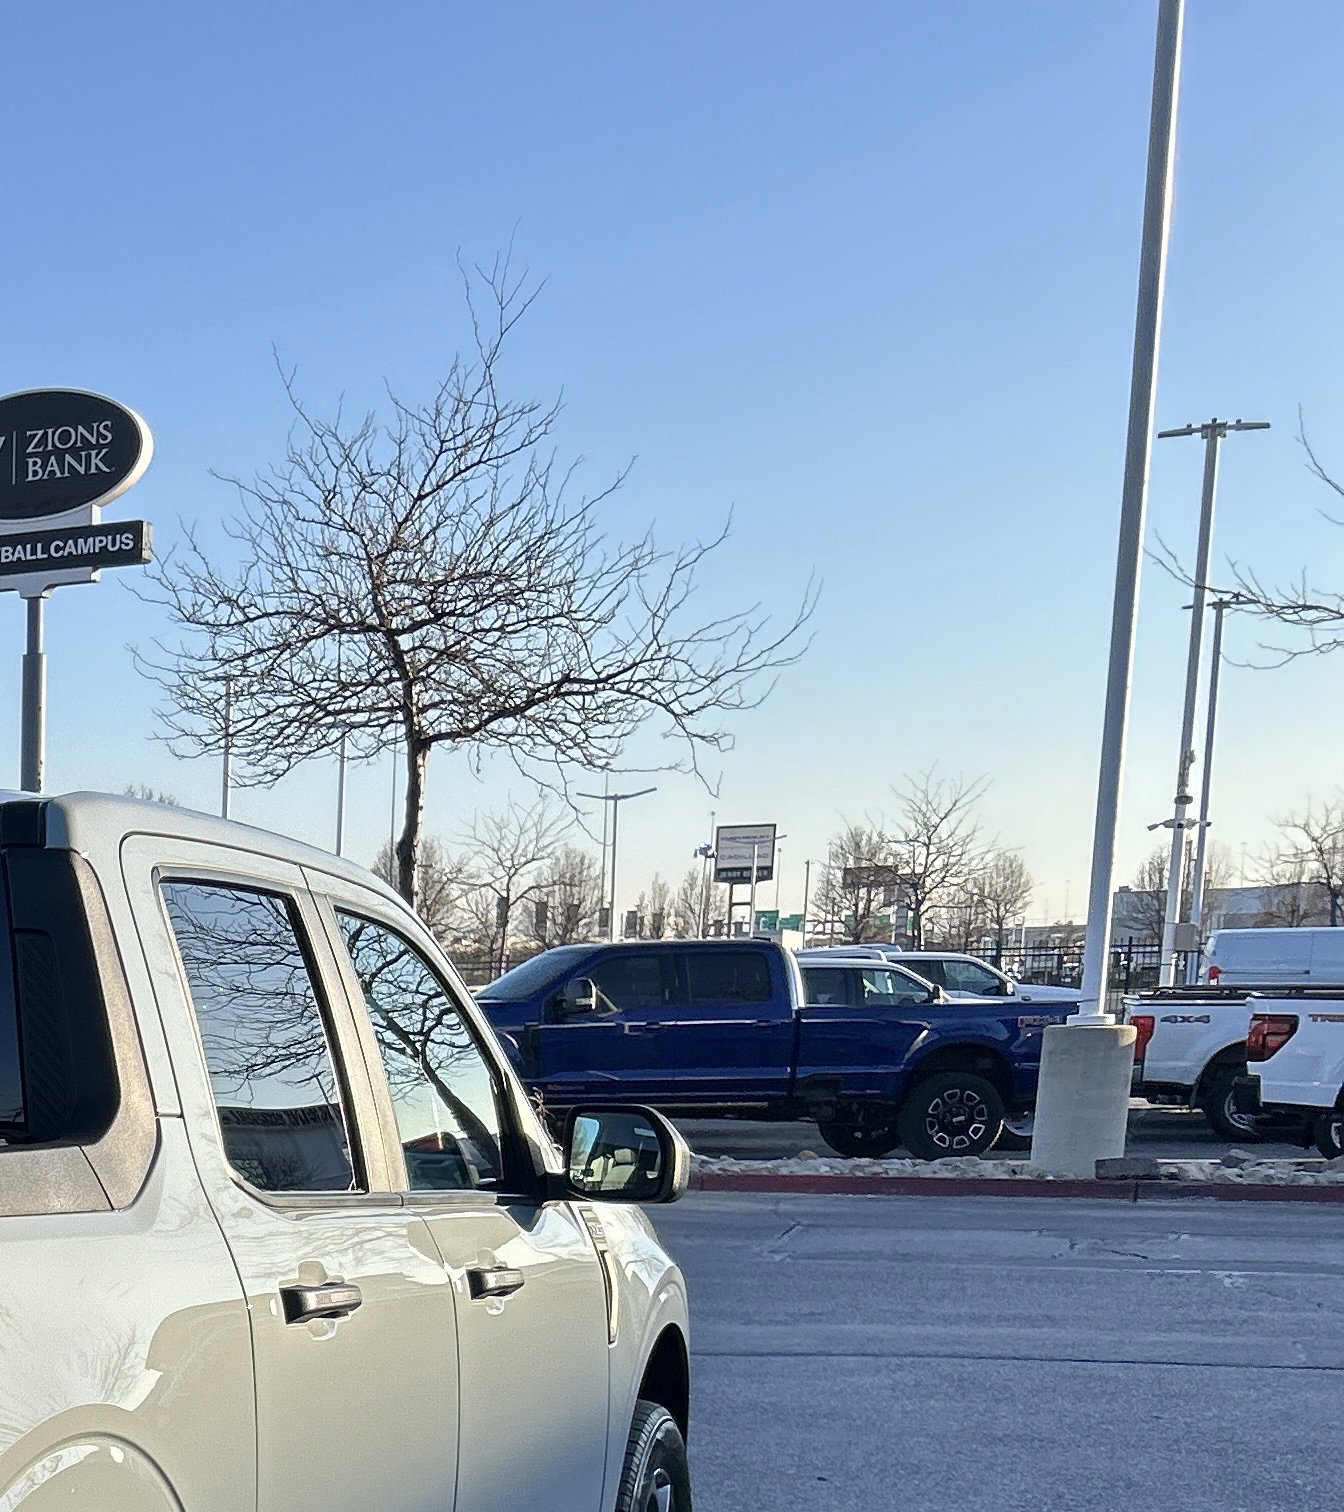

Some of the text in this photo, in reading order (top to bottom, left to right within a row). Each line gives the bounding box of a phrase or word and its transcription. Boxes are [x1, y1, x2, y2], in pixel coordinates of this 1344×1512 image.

[26, 420, 113, 453] ZIONS
[25, 449, 111, 482] BANK
[51, 532, 134, 558] CAMPUS
